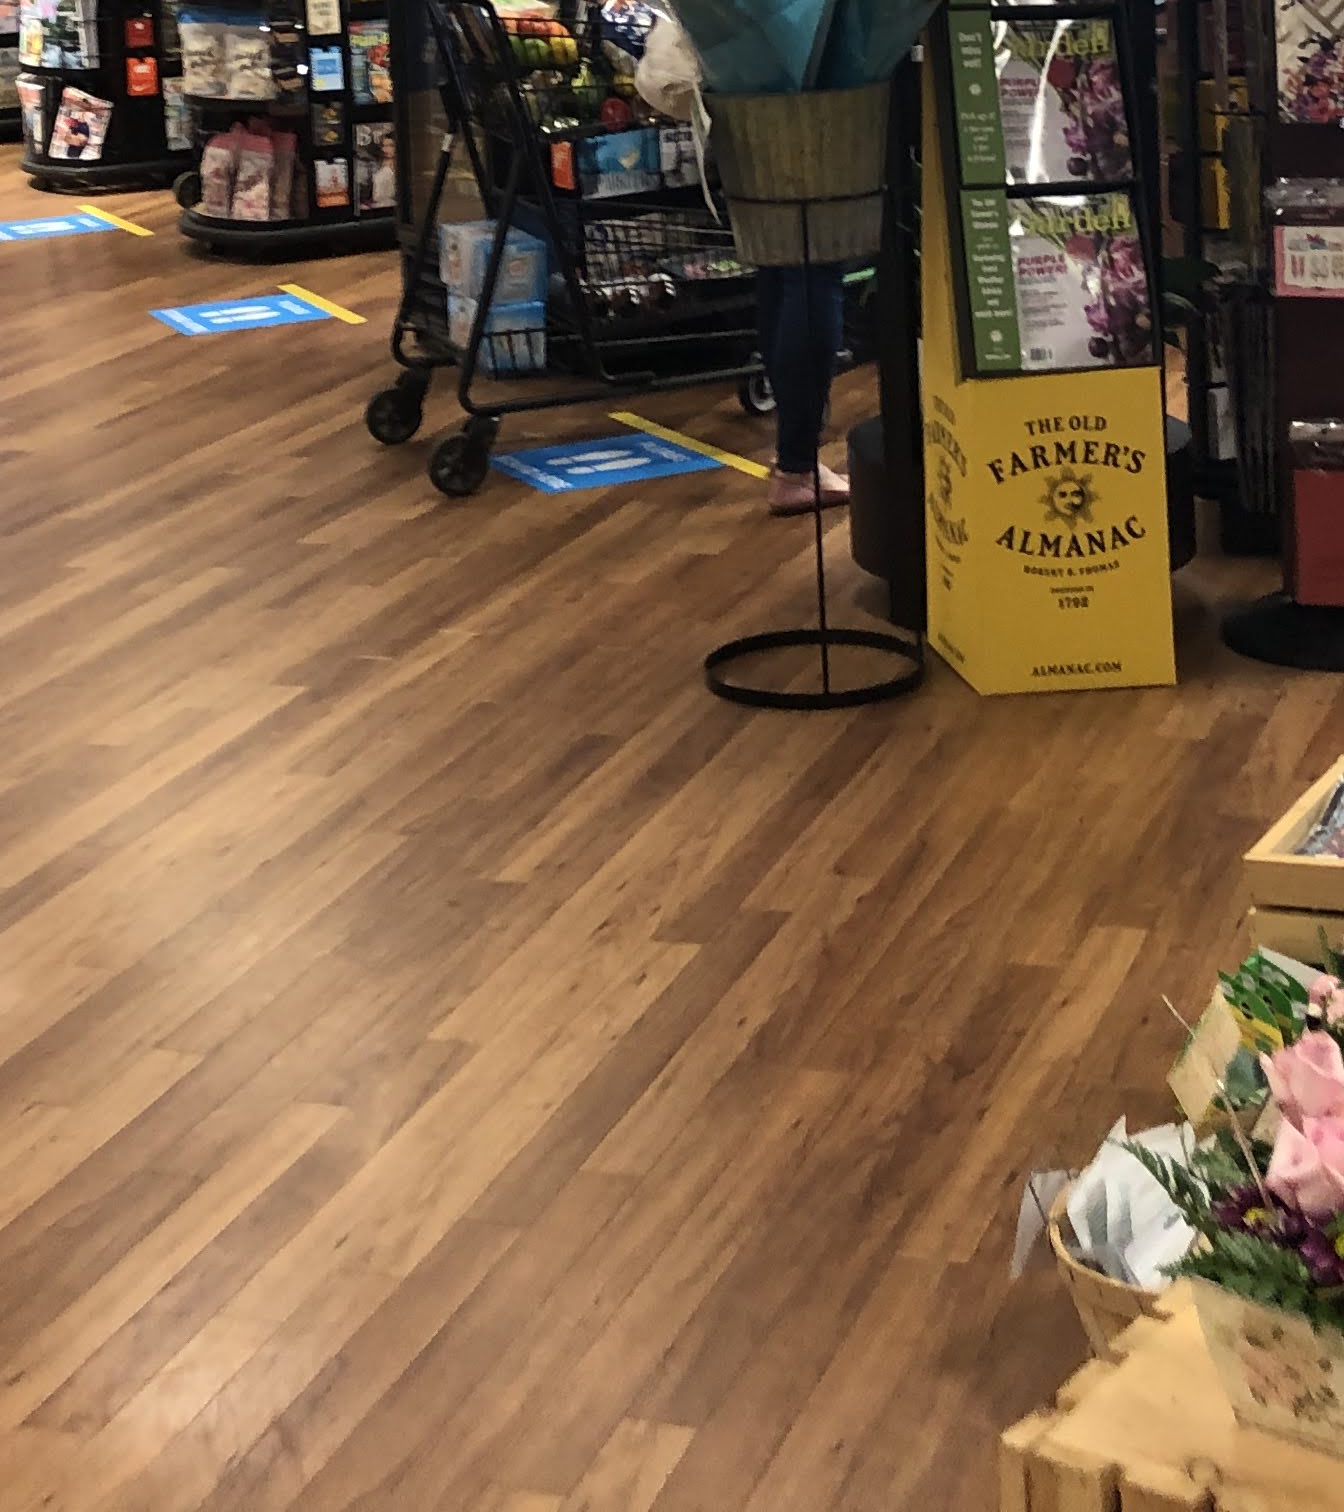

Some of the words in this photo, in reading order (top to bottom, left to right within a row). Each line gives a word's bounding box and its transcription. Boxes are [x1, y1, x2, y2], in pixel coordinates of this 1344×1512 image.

[1017, 254, 1066, 266] PURPLE
[1024, 417, 1064, 436] THE
[1068, 415, 1108, 433] OLD
[986, 439, 1147, 485] FARMER'S
[995, 515, 1147, 558] ALMANAC
[1030, 660, 1123, 678] ALMANAC.COM
